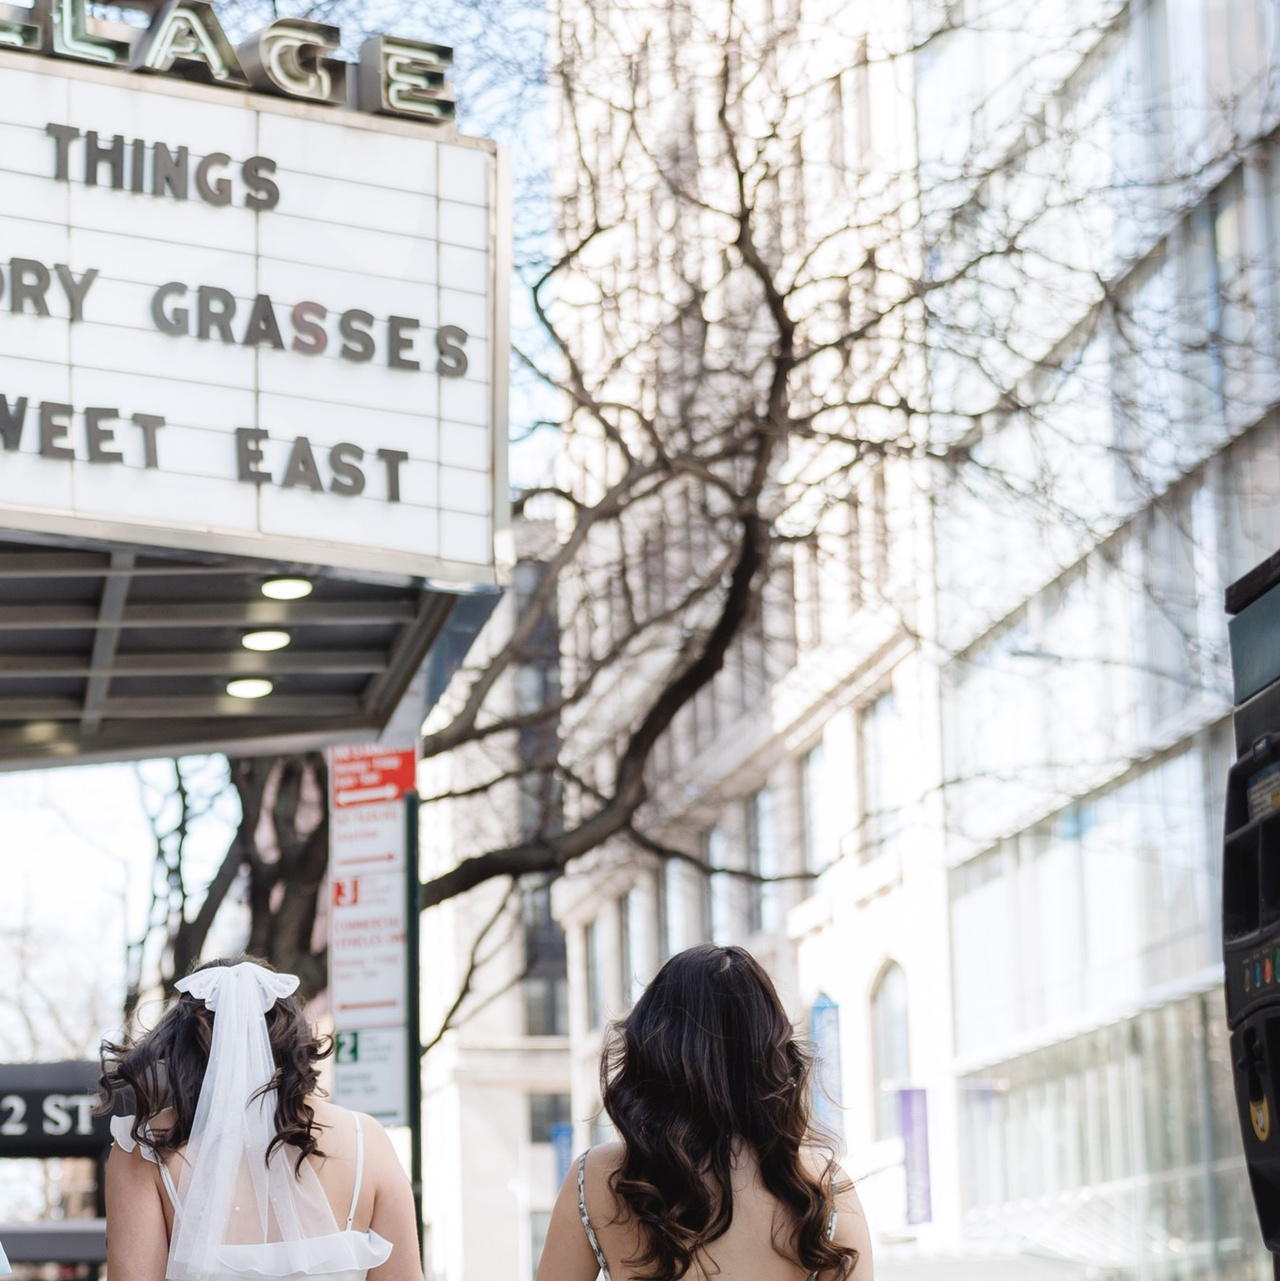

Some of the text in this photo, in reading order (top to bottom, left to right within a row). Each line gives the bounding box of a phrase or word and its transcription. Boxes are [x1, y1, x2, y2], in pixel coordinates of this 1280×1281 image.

[45, 122, 280, 210] THINGS
[151, 281, 469, 378] GRASSES
[235, 426, 409, 503] EAST
[339, 1032, 355, 1063] 2
[41, 1093, 99, 1137] ST
